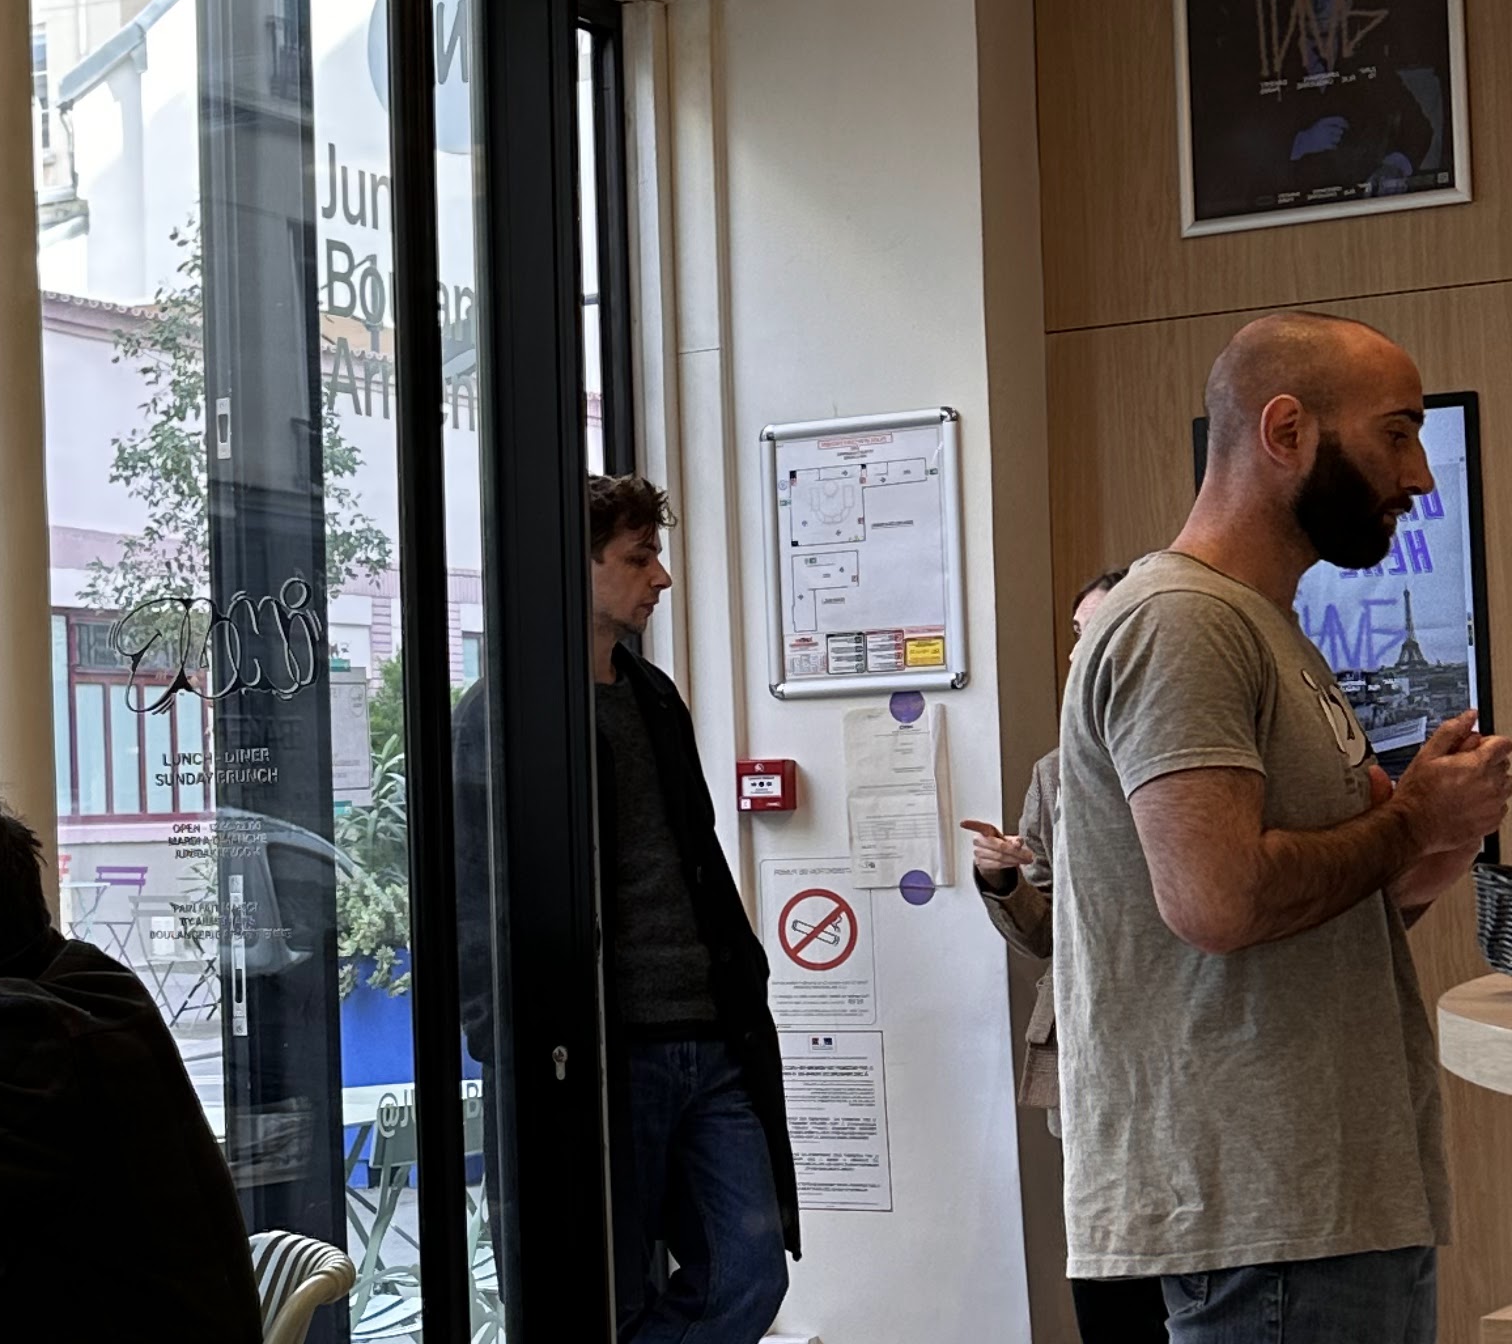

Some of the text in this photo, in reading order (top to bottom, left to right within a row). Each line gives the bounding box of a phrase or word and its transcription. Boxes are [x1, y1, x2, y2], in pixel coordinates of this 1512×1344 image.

[162, 752, 213, 767] LUNCH
[224, 747, 270, 764] DINER
[155, 767, 279, 787] SUNDAY BRUNCH
[172, 823, 201, 834] OPEN
